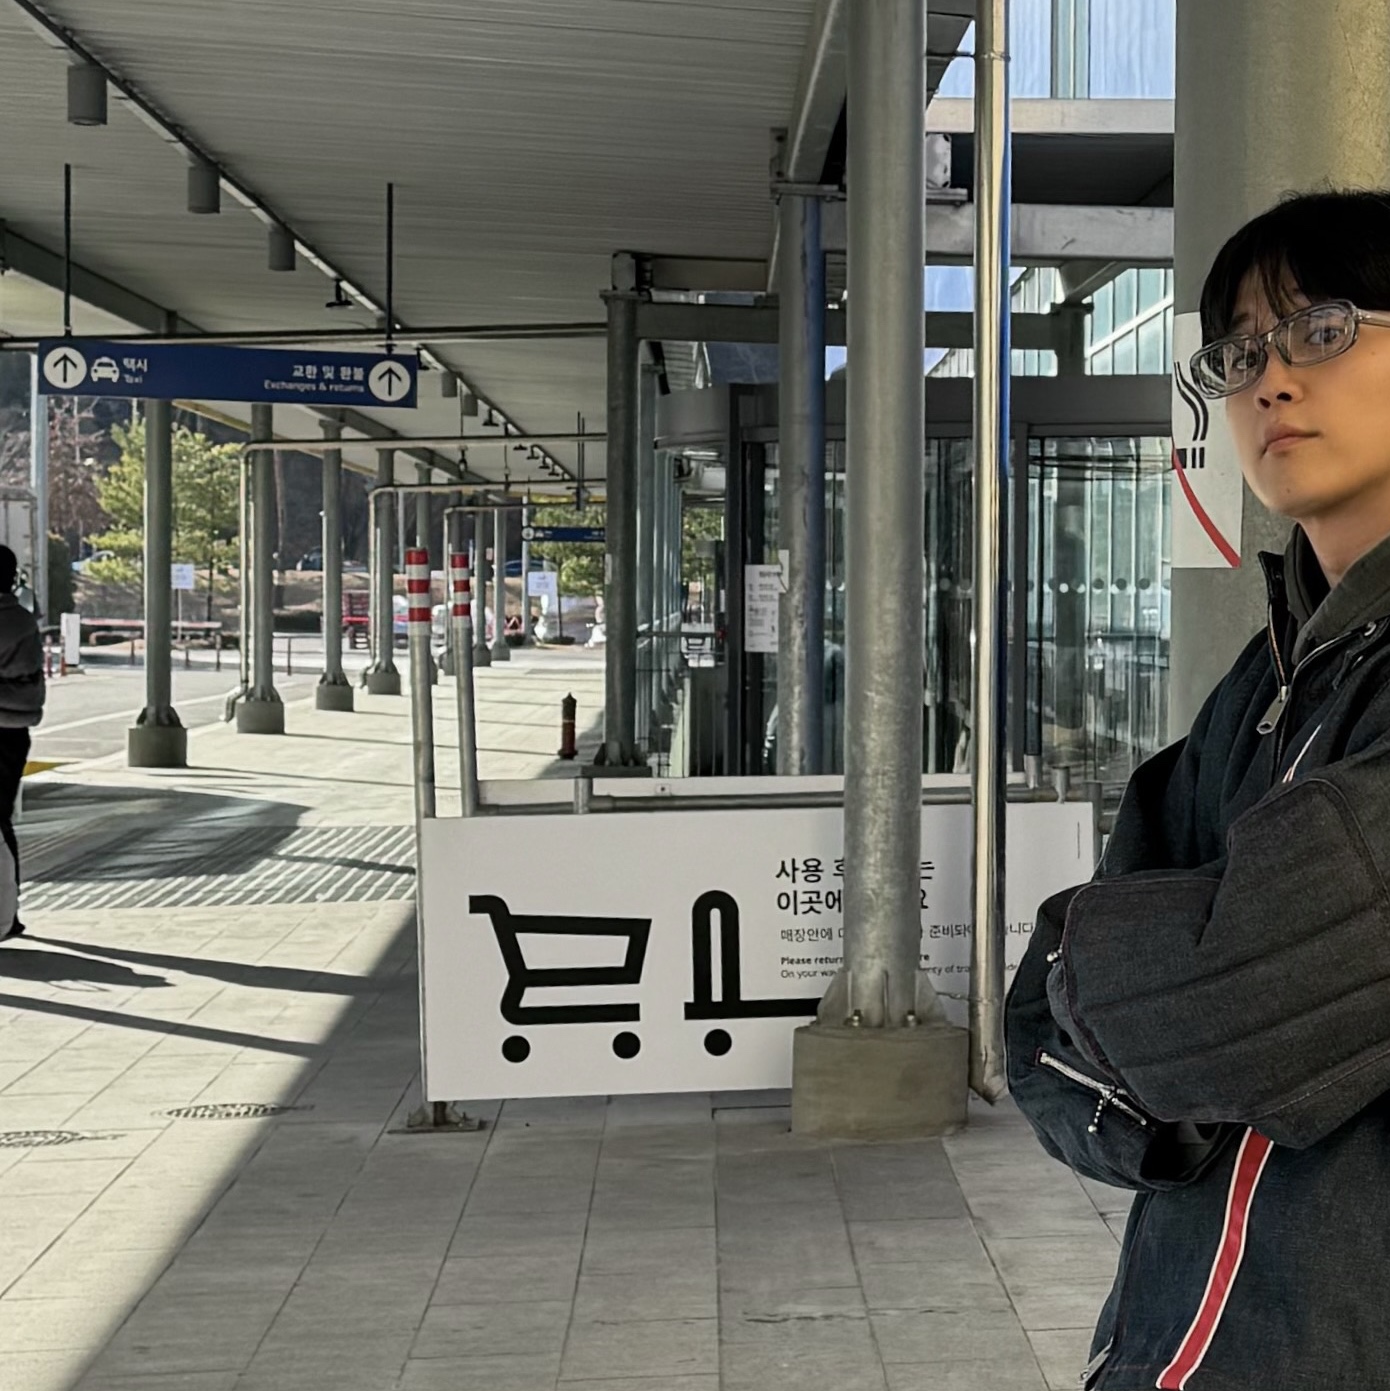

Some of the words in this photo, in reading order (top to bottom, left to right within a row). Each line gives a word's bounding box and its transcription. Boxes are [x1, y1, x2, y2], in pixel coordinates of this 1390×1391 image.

[123, 357, 148, 373] 택시
[292, 364, 318, 379] 교환
[322, 365, 334, 379] 및
[340, 366, 364, 381] 환불
[263, 379, 316, 392] Exchanges
[318, 382, 328, 391] &
[329, 383, 365, 393] returns
[775, 857, 825, 884] 사용
[780, 956, 812, 966] Please
[780, 969, 794, 979] On
[796, 970, 818, 981] your
[945, 964, 955, 974] of
